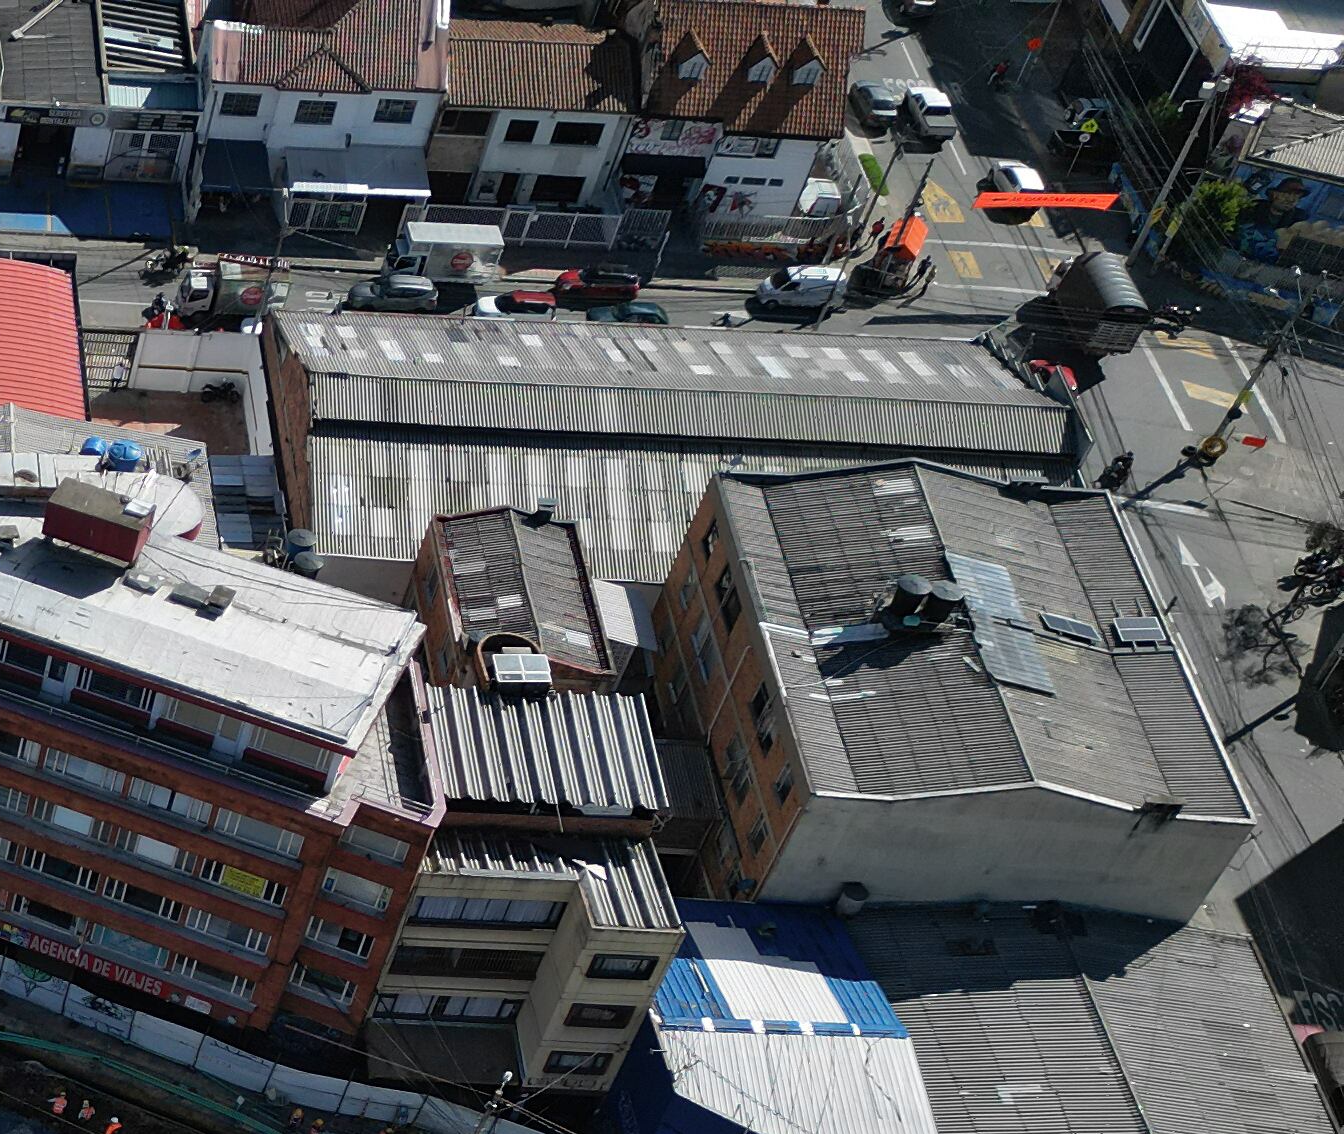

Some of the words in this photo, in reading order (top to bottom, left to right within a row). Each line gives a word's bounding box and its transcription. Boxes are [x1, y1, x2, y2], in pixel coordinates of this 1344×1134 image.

[30, 935, 90, 970] AGENCIA
[91, 958, 112, 977] DE
[114, 966, 163, 996] VIAJES
